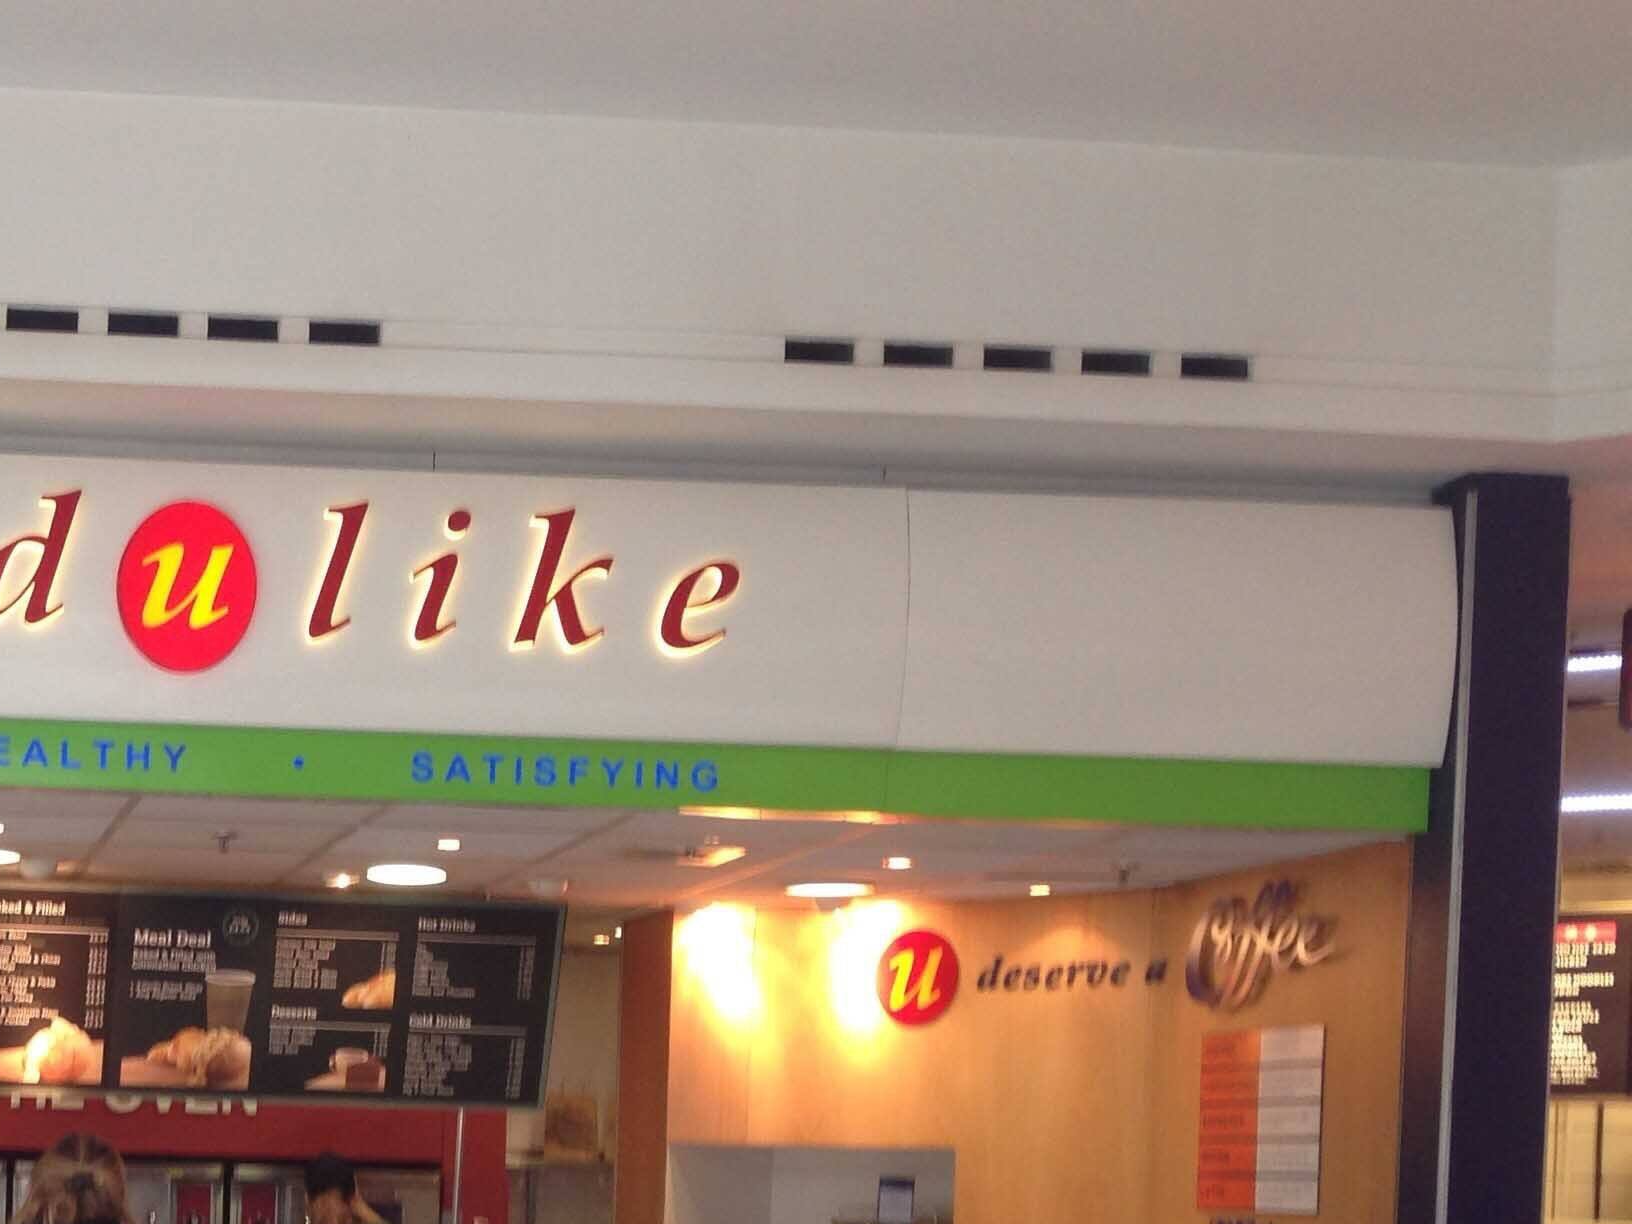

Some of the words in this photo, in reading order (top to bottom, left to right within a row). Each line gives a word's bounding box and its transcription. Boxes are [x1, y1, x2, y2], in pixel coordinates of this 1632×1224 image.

[303, 500, 742, 652] like
[411, 751, 721, 794] SATISFYING
[134, 928, 173, 947] Meal
[177, 929, 212, 949] Deal
[976, 954, 1131, 994] deserve
[1144, 956, 1168, 986] a
